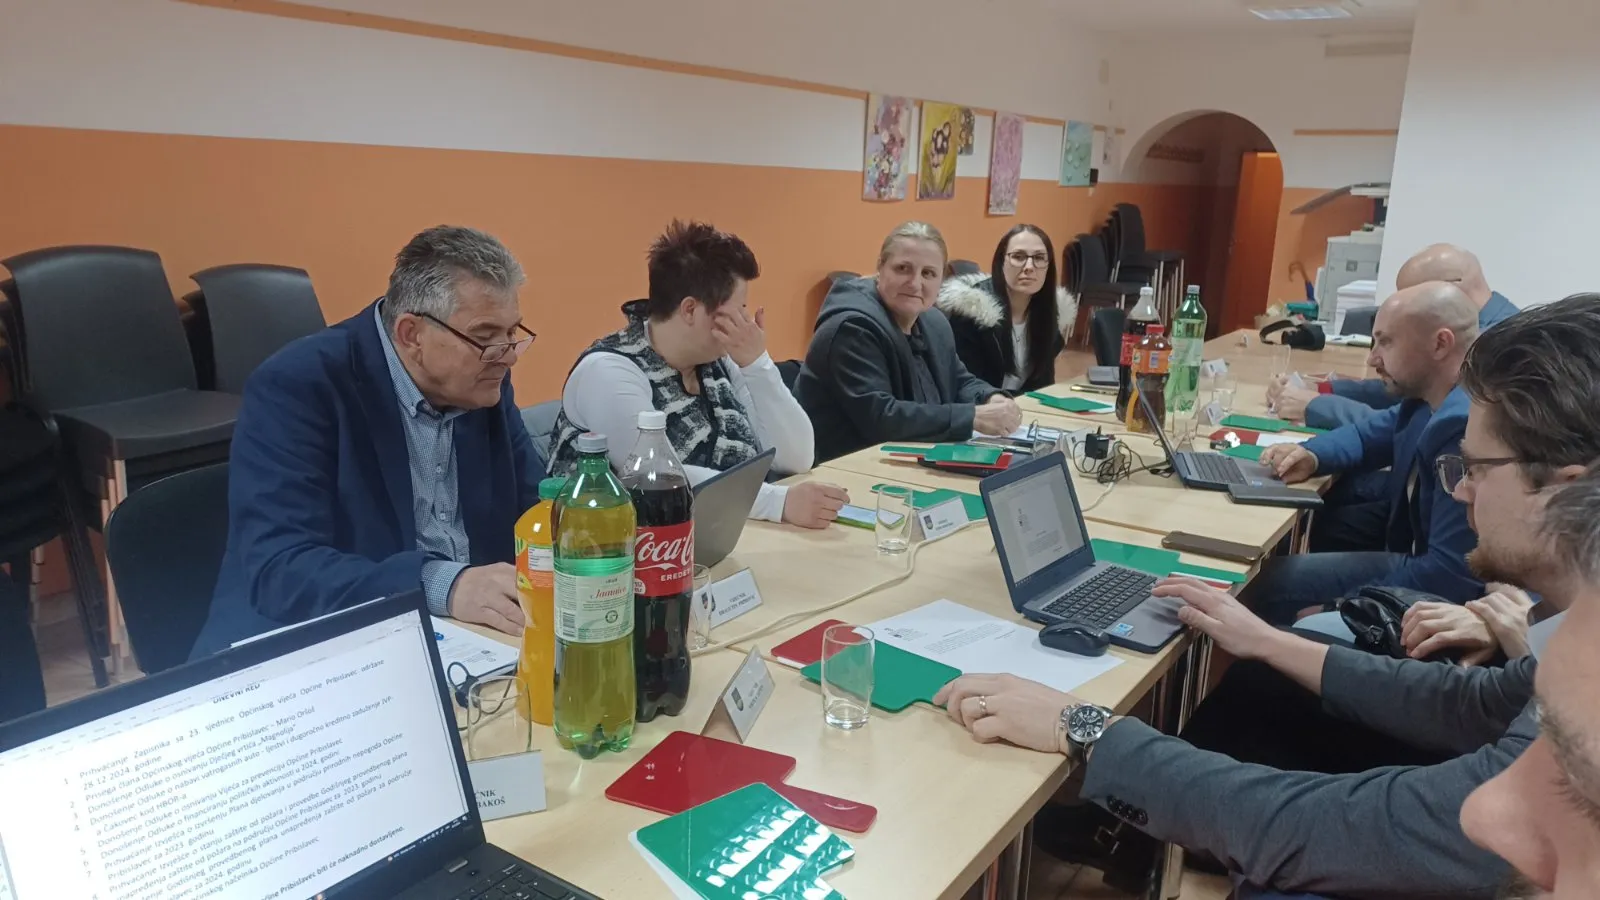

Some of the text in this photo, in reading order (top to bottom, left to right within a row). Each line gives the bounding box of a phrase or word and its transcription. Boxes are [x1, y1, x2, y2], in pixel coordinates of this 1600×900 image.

[133, 740, 170, 758] Zapisnika
[205, 716, 234, 731] sjednice
[238, 701, 274, 718] Općinskog
[277, 692, 296, 703] vijeća
[299, 682, 322, 694] Općine
[325, 669, 357, 684] Pribislavec
[360, 659, 384, 671] održane
[85, 786, 116, 802] Prisega
[141, 759, 183, 779] Općinskog
[183, 750, 204, 762] vijeća
[206, 740, 231, 754] Općine
[232, 725, 268, 743] Pribislavec
[276, 714, 295, 726] Mario
[88, 791, 132, 813] Donošenje
[134, 779, 162, 794] Odluke
[172, 761, 207, 779] osnivanju
[89, 802, 135, 825] Donošenje
[136, 790, 165, 806] Odluke
[174, 774, 200, 790] nabavi
[201, 756, 242, 779] vatrogasnih
[244, 751, 260, 761] auto
[290, 724, 324, 742] dugoročno
[324, 713, 350, 727] kreditno
[352, 701, 380, 716] zaduženje
[97, 824, 142, 847] Donošenje
[144, 811, 172, 827] Odluke
[181, 792, 216, 811] osnivanju
[218, 782, 239, 795] Vijeća
[250, 763, 285, 783] prevenciju
[286, 753, 308, 766] Općine
[309, 738, 343, 755] Pribislavec
[134, 756, 162, 772] godine
[228, 802, 248, 814] Plana
[250, 786, 284, 804] djelovanja
[293, 769, 321, 787] području
[323, 754, 351, 774] prirodnih
[352, 742, 381, 758] nepogoda
[382, 733, 402, 745] Općine
[100, 835, 145, 858] Donošenje
[147, 822, 175, 838] Odluke
[183, 799, 227, 822] financiranju
[229, 783, 260, 804] političkih
[262, 768, 294, 787] aktivnosti
[102, 814, 137, 832] Čakovec
[139, 806, 154, 817] kod
[168, 863, 193, 878] zaštite
[195, 856, 205, 865] od
[206, 845, 231, 861] požara
[243, 825, 274, 844] području
[274, 813, 298, 827] Općine
[299, 797, 332, 815] Pribislavec
[361, 774, 381, 788] godinu
[200, 837, 222, 851] stanju
[224, 826, 247, 840] zaštite
[249, 819, 258, 828] od
[260, 809, 283, 825] požara
[288, 792, 319, 812] provedbe
[320, 778, 351, 795] Godišnjeg
[352, 759, 391, 782] provedbenog
[392, 751, 407, 763] plana
[208, 844, 256, 872] provedbenog
[259, 834, 277, 848] plana
[280, 813, 321, 836] unapređenja
[346, 796, 354, 804] od
[356, 787, 376, 801] požara
[387, 770, 411, 786] područje
[107, 858, 151, 881] Pribislavec
[187, 829, 214, 847] godinu
[224, 866, 258, 886] načelnika
[259, 854, 283, 869] Općine
[284, 836, 319, 856] Pribislavec
[226, 858, 251, 876] godinu
[280, 872, 316, 894] Pribislavec
[316, 864, 327, 874] biti
[337, 844, 368, 864] naknadno
